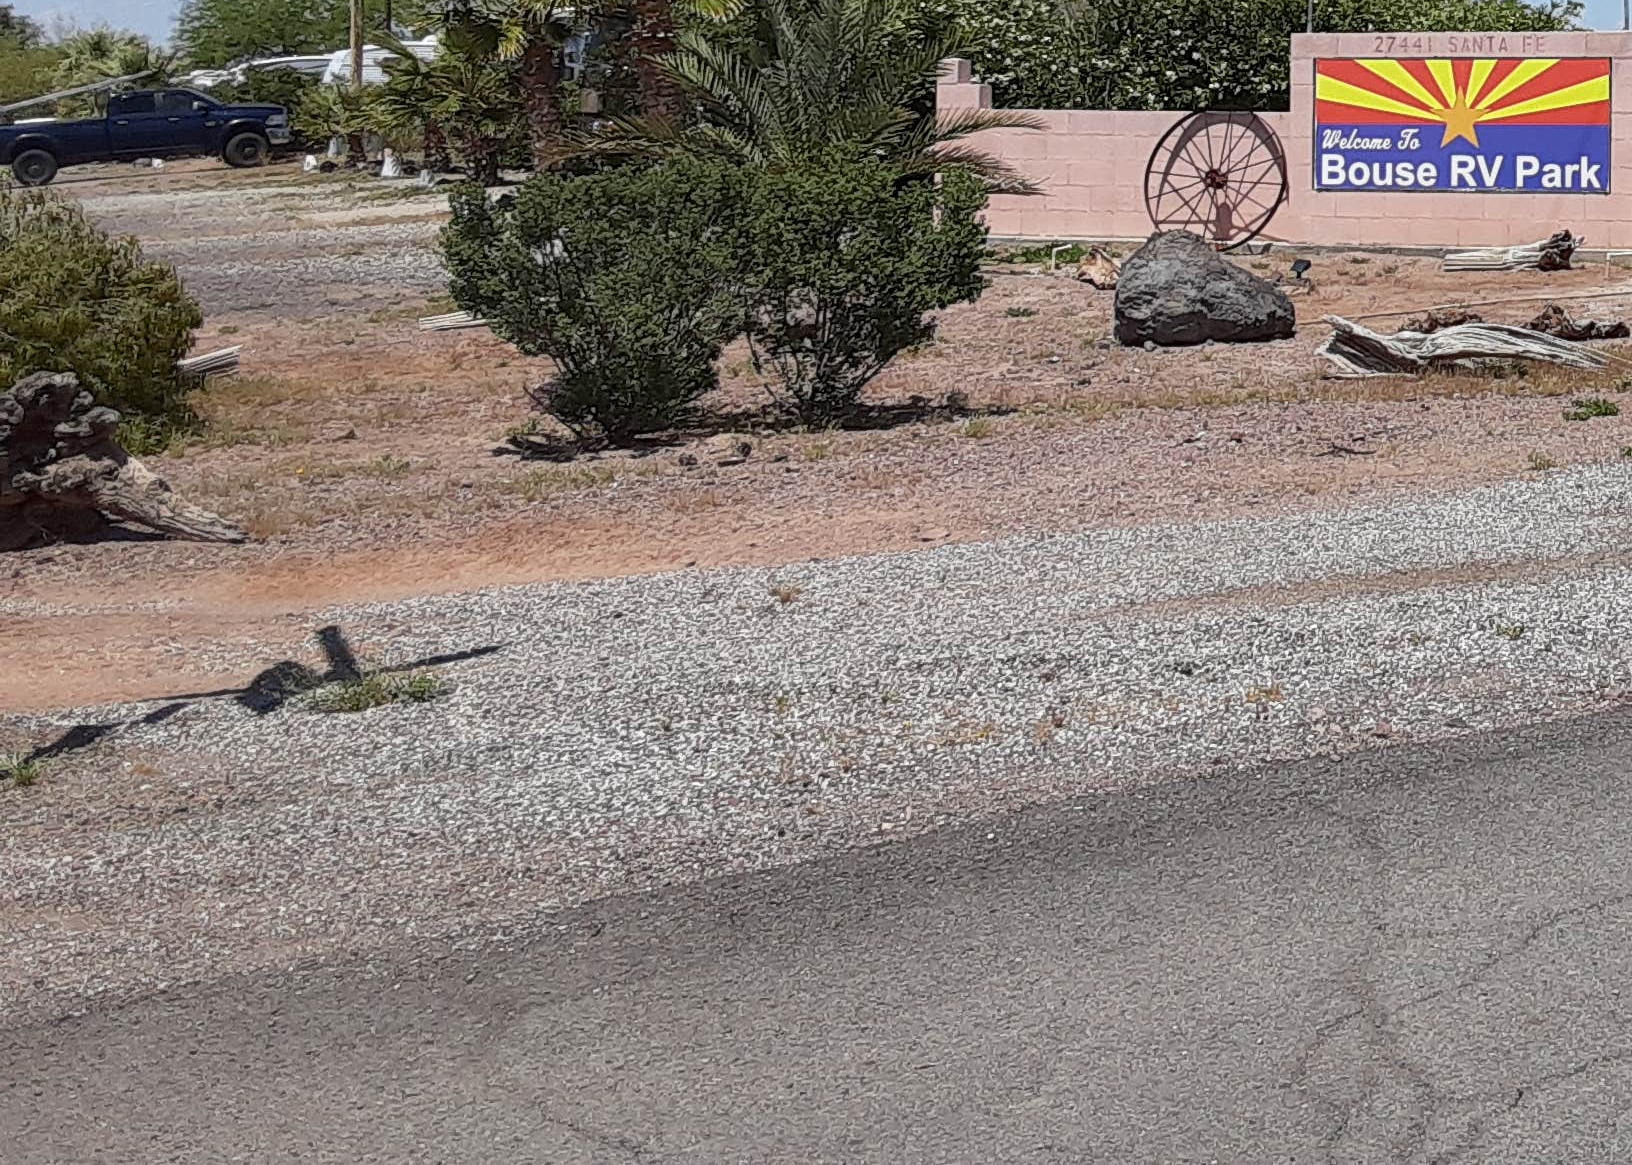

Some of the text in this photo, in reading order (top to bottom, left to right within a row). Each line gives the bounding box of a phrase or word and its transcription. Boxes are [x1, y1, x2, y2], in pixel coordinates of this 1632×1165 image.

[1374, 35, 1546, 54] 27441 SANTA FE
[1322, 127, 1421, 151] Welcome To
[1321, 153, 1601, 189] Bouse RV Park
